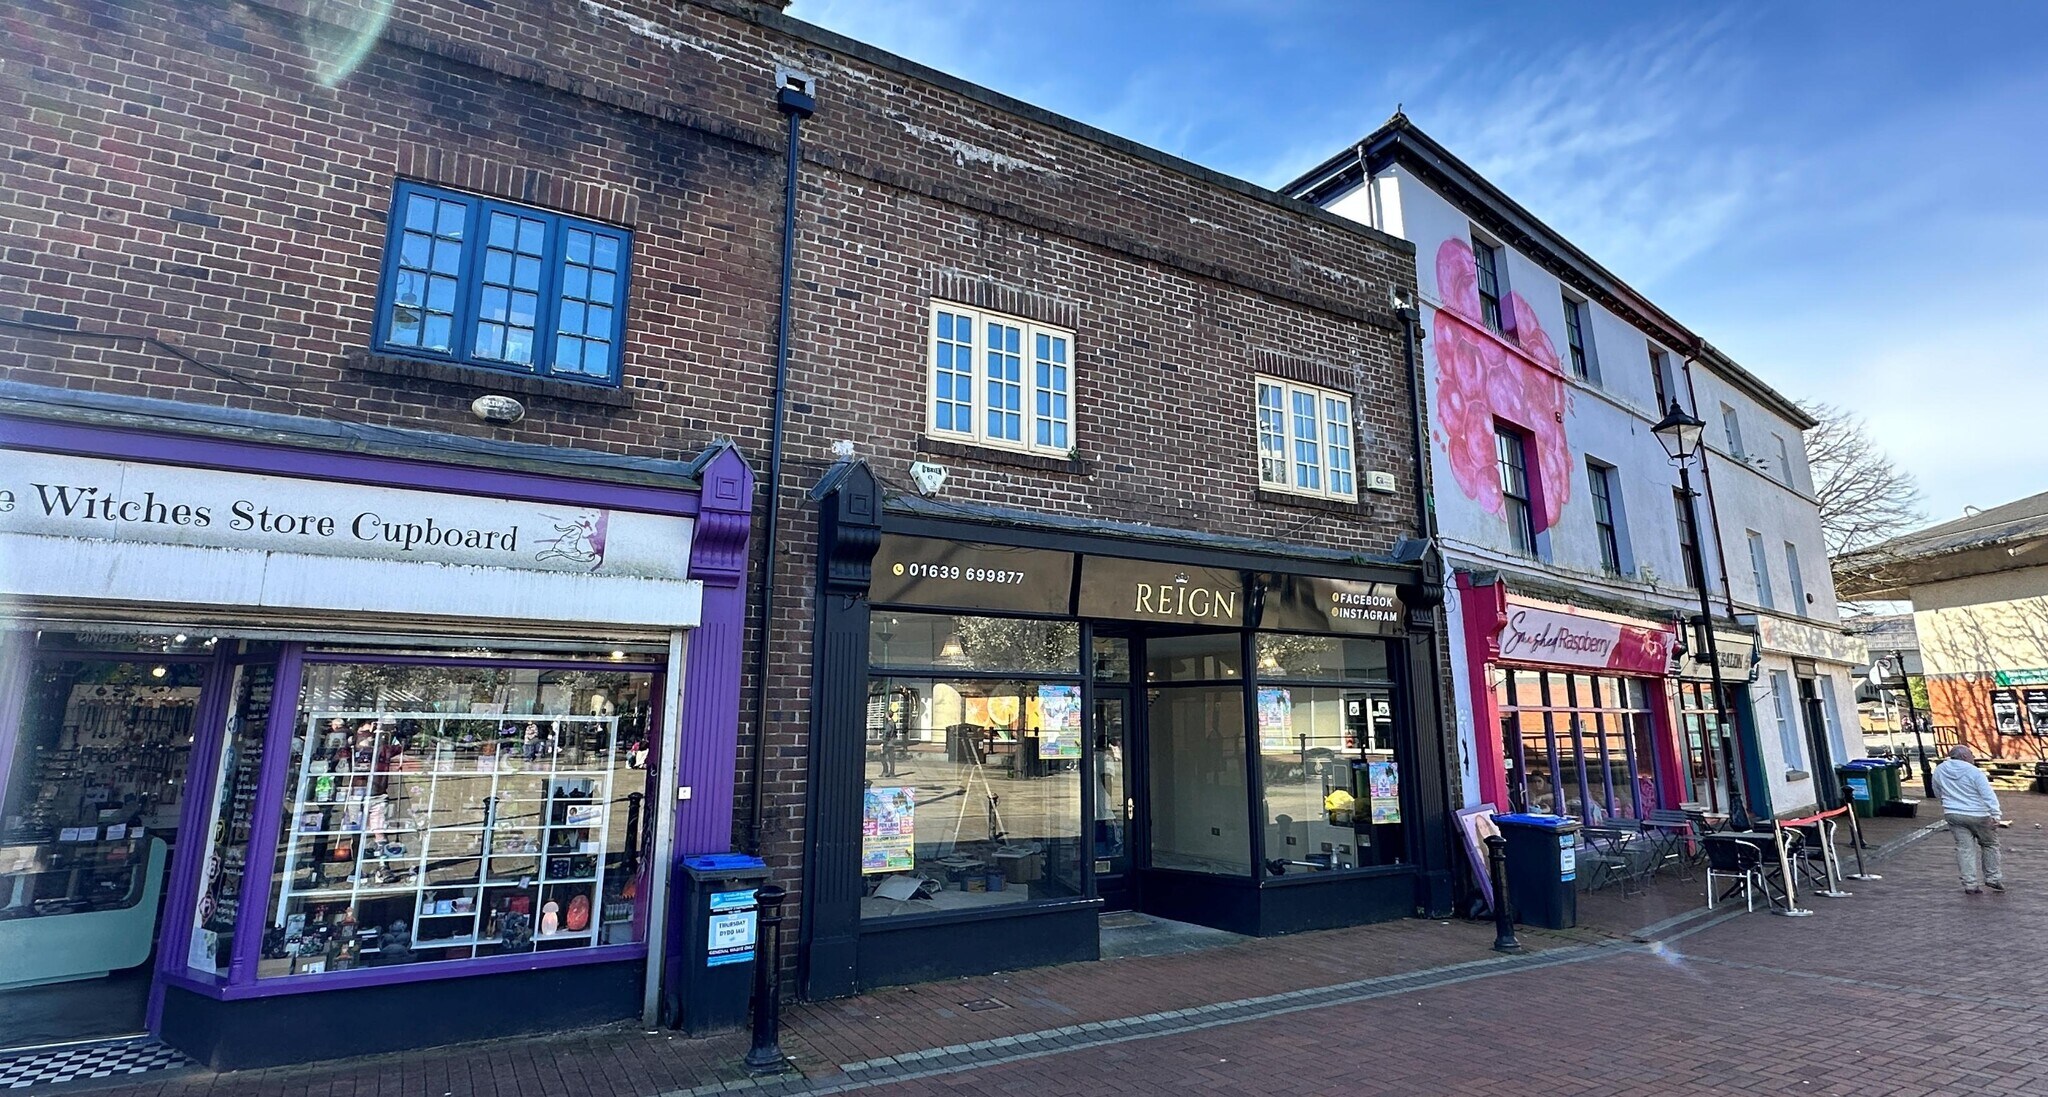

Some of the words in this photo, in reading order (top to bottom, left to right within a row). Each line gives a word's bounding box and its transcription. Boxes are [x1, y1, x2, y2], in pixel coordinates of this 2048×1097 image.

[30, 482, 211, 527] Witches
[229, 499, 335, 537] Store
[351, 511, 519, 552] Cupboard
[908, 562, 961, 580] 01639
[965, 567, 1025, 585] 699877
[1134, 583, 1236, 619] REIGN
[1339, 592, 1394, 608] FACEBOOK
[1338, 607, 1398, 622] INSTAGRAM
[1558, 626, 1612, 658] Raspberry
[719, 921, 746, 929] THURSDAY
